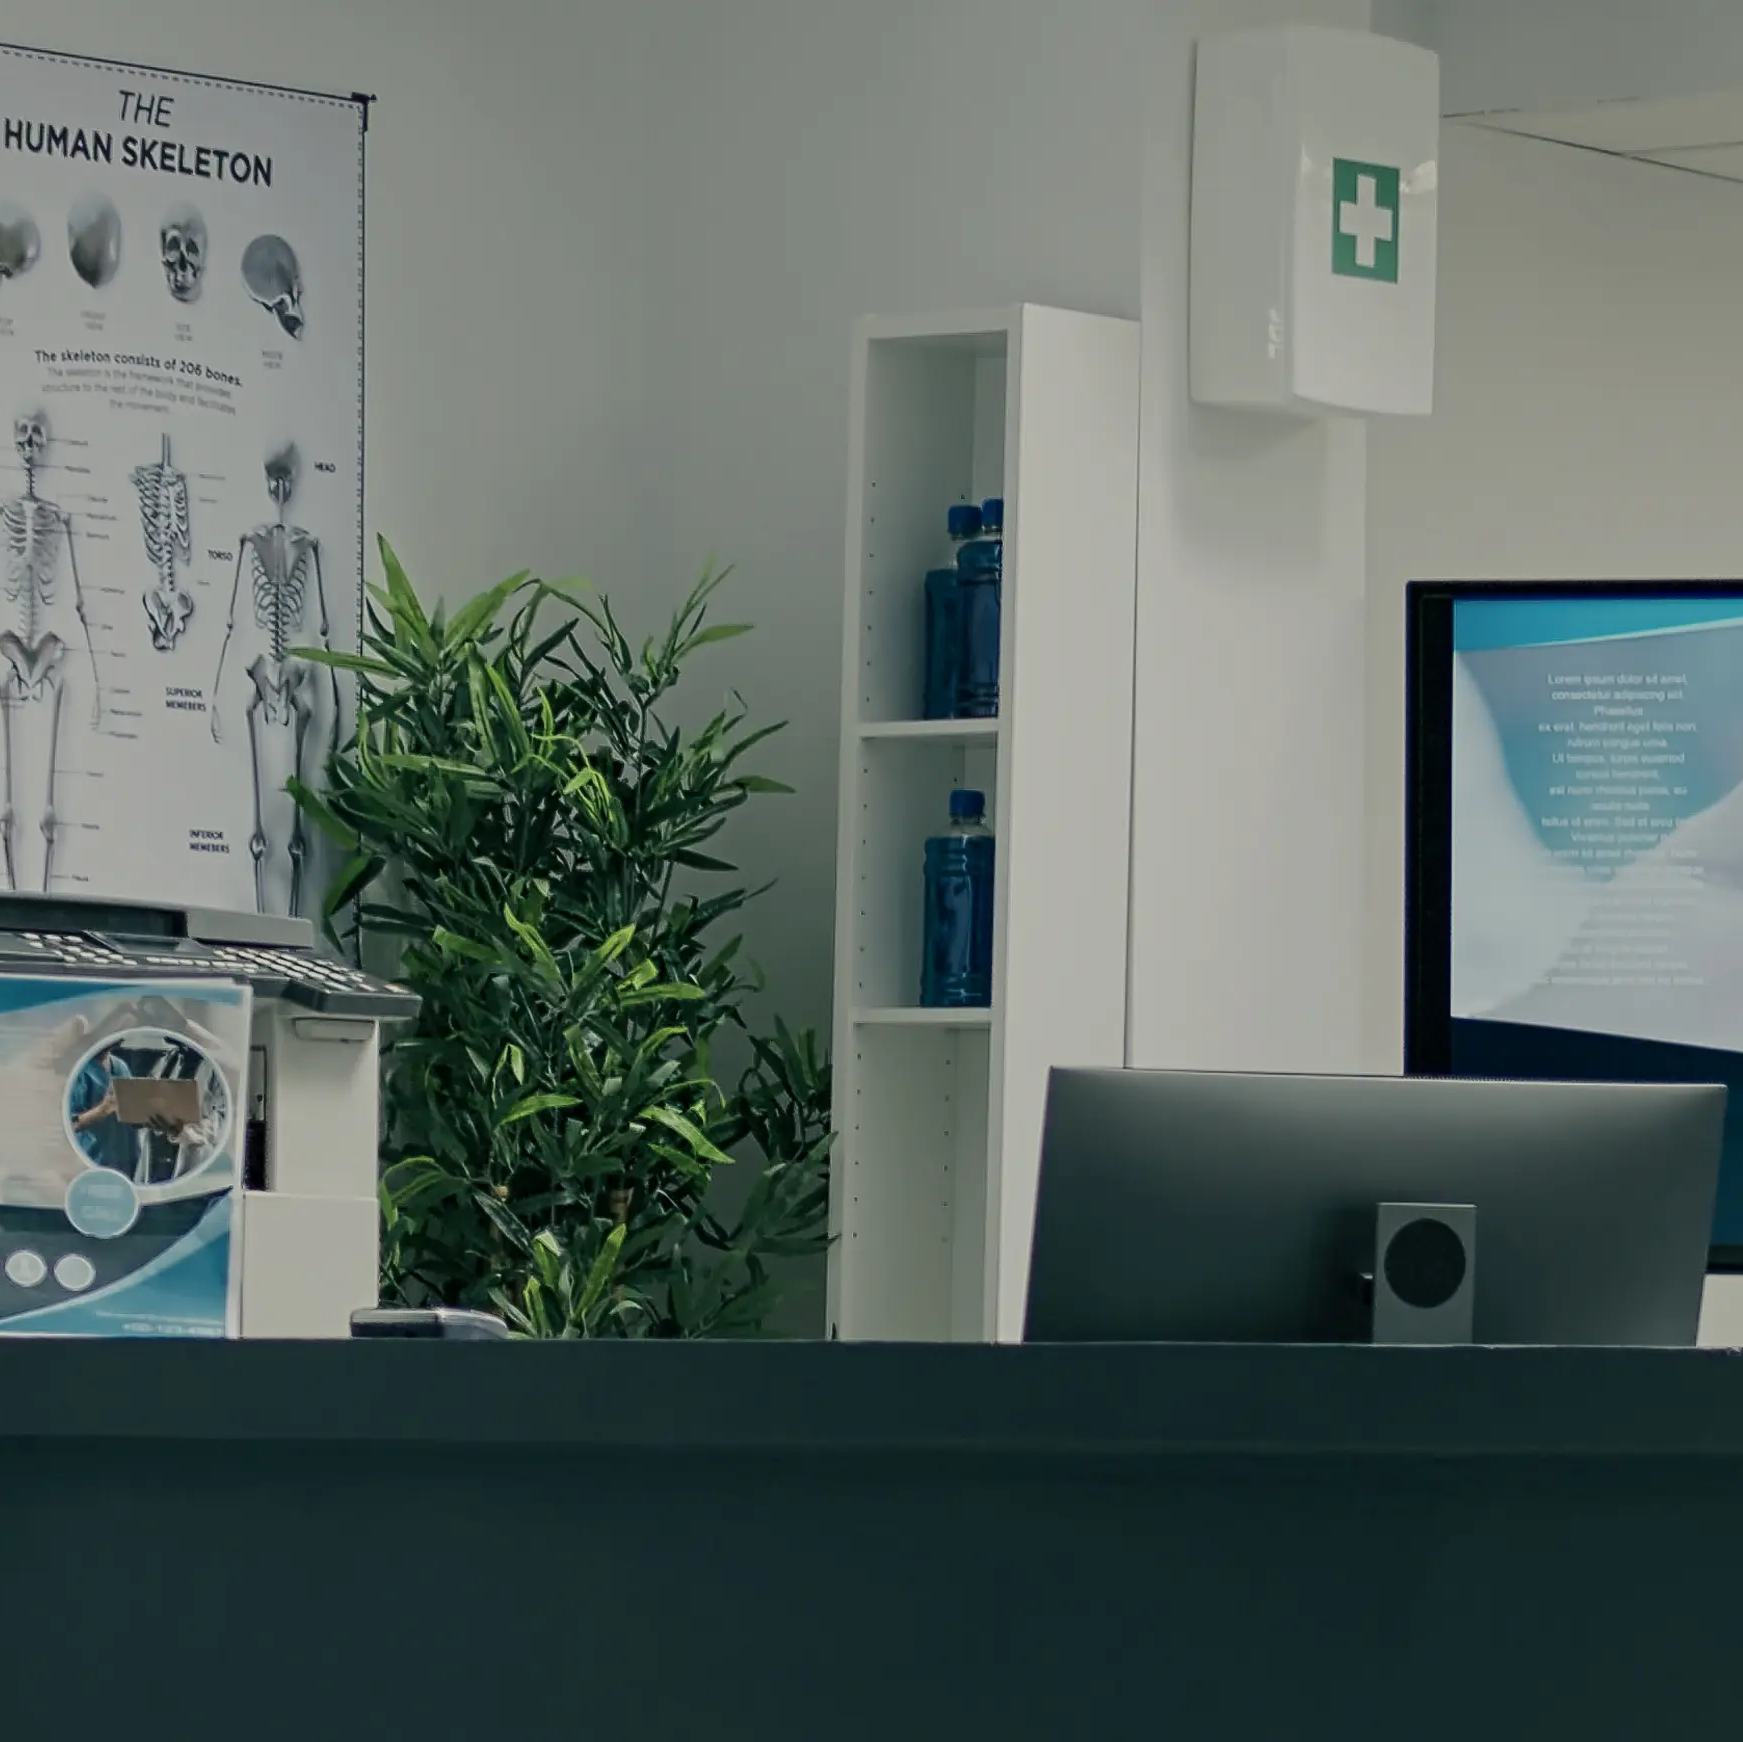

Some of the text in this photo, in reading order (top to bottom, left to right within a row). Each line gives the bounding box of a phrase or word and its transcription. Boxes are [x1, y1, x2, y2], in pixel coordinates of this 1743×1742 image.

[119, 89, 174, 127] THE
[4, 117, 273, 187] HUMAN SKELETON
[34, 350, 243, 388] The skeleton consists of 206 bones.
[314, 461, 337, 473] HEAD
[207, 549, 233, 562] TORSO
[1548, 674, 1582, 684] Lorem
[1584, 674, 1615, 687] ipsum
[1617, 673, 1643, 684] dolor
